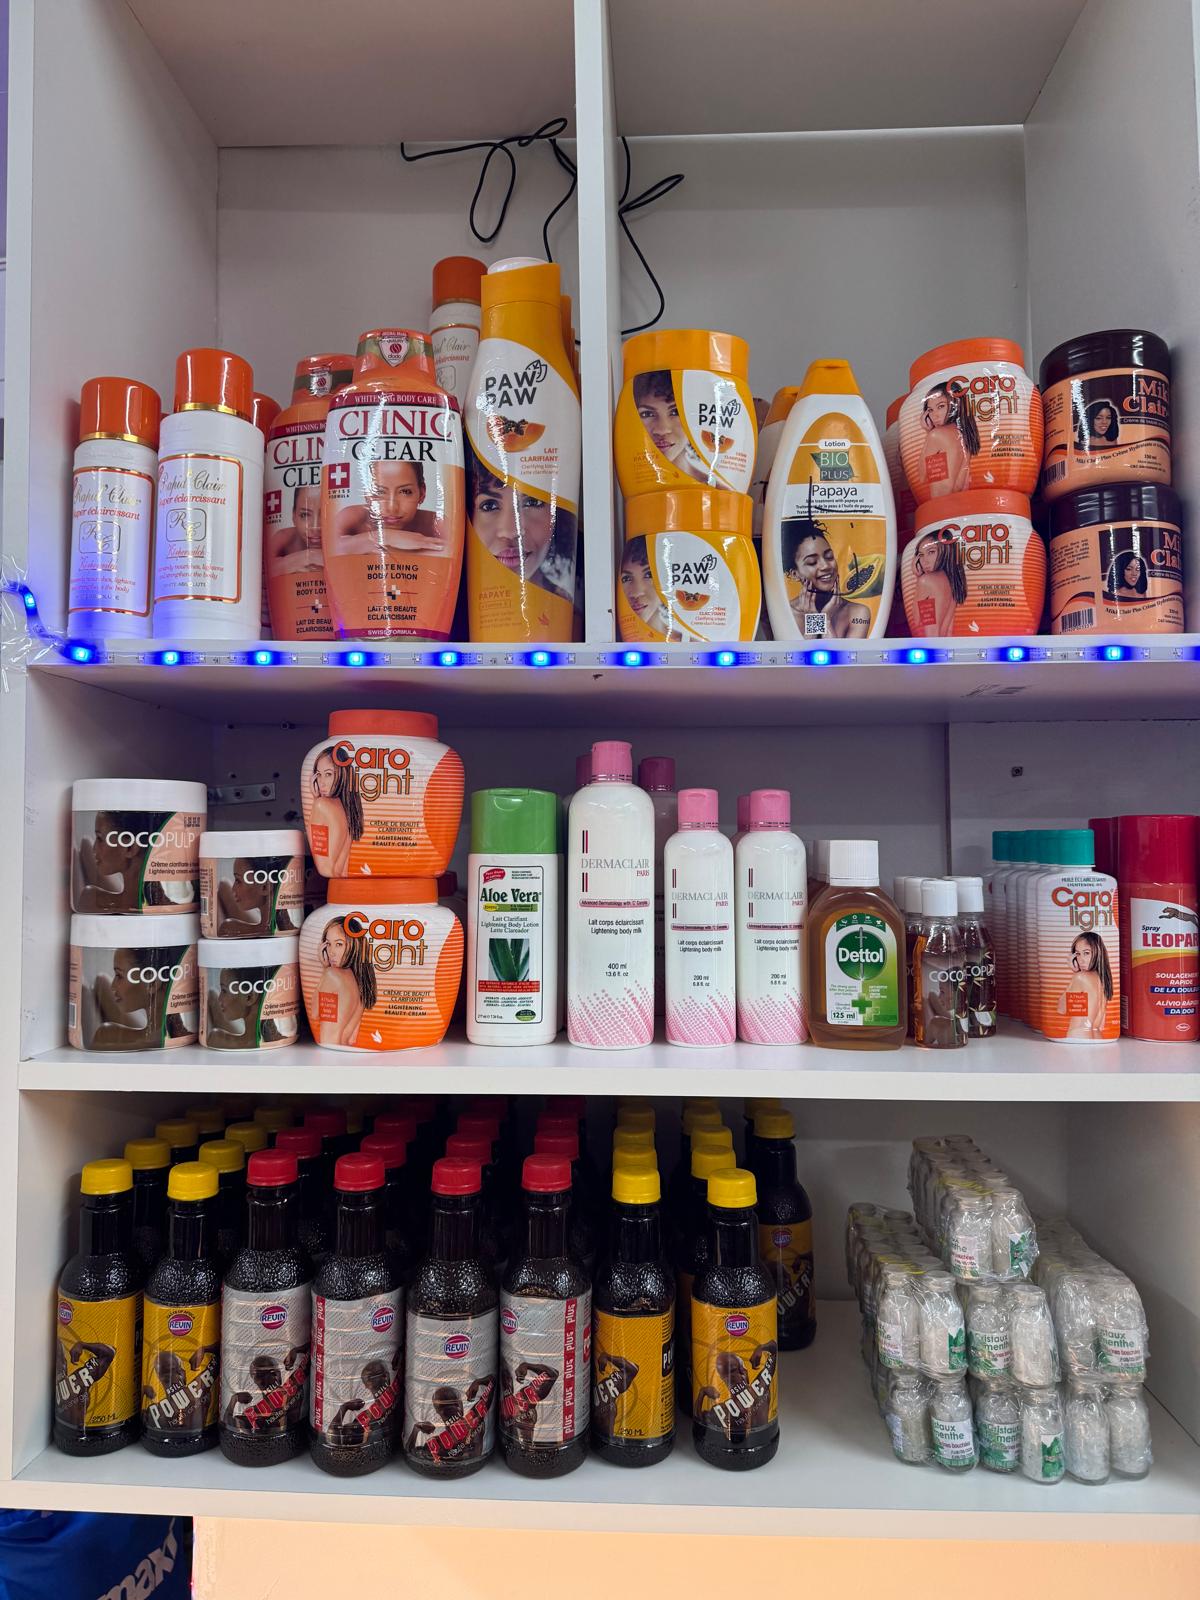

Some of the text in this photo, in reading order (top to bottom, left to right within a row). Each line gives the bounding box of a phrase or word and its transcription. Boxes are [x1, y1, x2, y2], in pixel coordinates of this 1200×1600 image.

[486, 371, 537, 392] PAW
[946, 376, 1016, 398] Caro
[397, 395, 416, 403] BODY
[417, 396, 437, 404] CARE
[486, 387, 538, 409] PAW
[699, 403, 734, 416] PAW
[286, 424, 319, 433] WHITENING
[339, 411, 452, 437] CLINIC
[698, 414, 734, 428] PAW
[274, 437, 325, 465] CLIN
[352, 440, 437, 462] CLEAR
[820, 452, 849, 466] BIO
[283, 467, 321, 487] CLE
[821, 470, 849, 481] PLUS
[812, 484, 858, 499] Papaya
[938, 524, 1010, 545] Caro
[955, 540, 1012, 571] light
[367, 564, 419, 572] WHITENING
[672, 563, 710, 575] PAW
[367, 572, 389, 580] BODY
[672, 573, 710, 585] PAW
[297, 588, 313, 596] BODY
[332, 740, 411, 771] Caro
[350, 766, 415, 802] light
[106, 831, 195, 848] COCOPULP
[581, 858, 650, 870] DERMACLAIR
[480, 887, 540, 902] Aloe Vera
[672, 892, 728, 900] DERMACLAIR
[748, 891, 803, 900] DERMACLAIR
[1052, 887, 1112, 907] Caro
[1070, 905, 1112, 931] light
[344, 911, 425, 941] Caro
[591, 927, 618, 935] Lightening
[361, 937, 428, 972] light
[838, 947, 884, 963] Dettol
[261, 1312, 286, 1322] REVIN
[373, 1314, 394, 1325] REVIN
[169, 1321, 193, 1329] REVIN
[726, 1321, 748, 1330] REVIN
[445, 1342, 470, 1352] REVIN
[565, 1304, 575, 1434] plus plus plus plus plus
[149, 1369, 215, 1429] POWER
[244, 1367, 306, 1429] POWER
[713, 1367, 773, 1429] POWER
[427, 1400, 488, 1464] POWER
[936, 1431, 965, 1440] enthe
